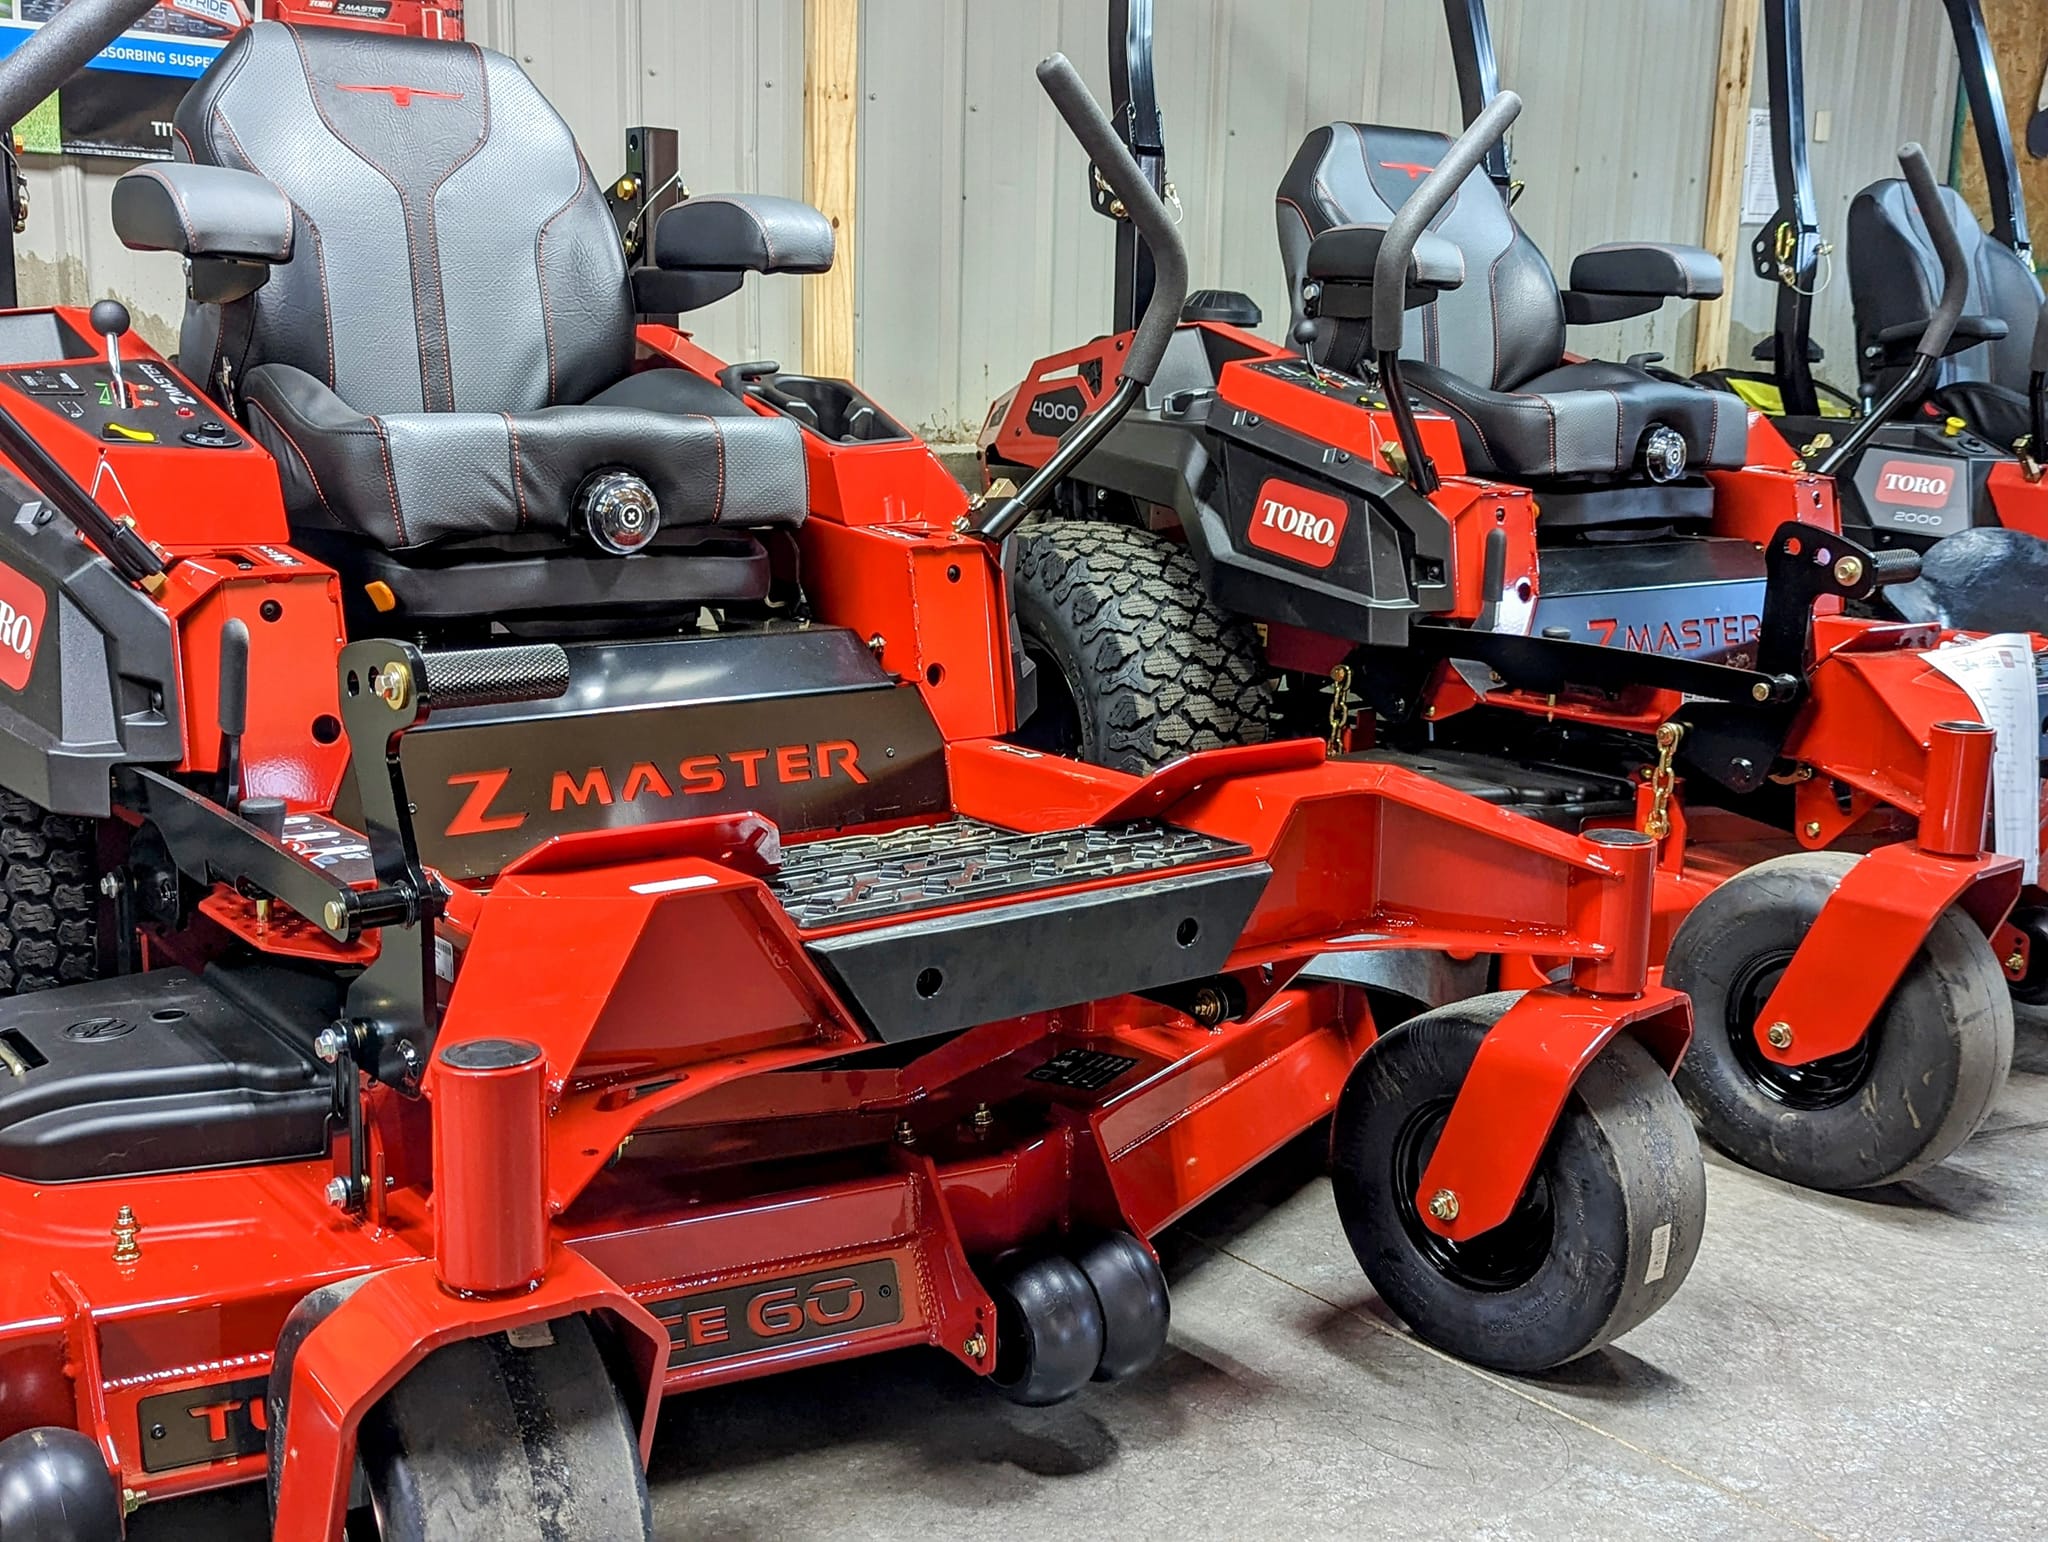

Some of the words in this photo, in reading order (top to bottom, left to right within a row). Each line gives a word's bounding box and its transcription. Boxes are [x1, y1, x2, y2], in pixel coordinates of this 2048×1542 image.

[347, 5, 386, 14] MASTER
[100, 47, 166, 63] BSORBING
[169, 53, 213, 68] SUSPE
[151, 121, 173, 137] TIT
[1032, 400, 1078, 422] 4000
[1886, 473, 1946, 495] TORO
[1262, 499, 1335, 545] TORO
[1893, 511, 1942, 526] 2000
[0, 600, 32, 654] RO
[1625, 614, 1761, 653] MASTER
[444, 768, 530, 837] Z
[549, 738, 870, 811] MASTER
[747, 1276, 865, 1337] 60
